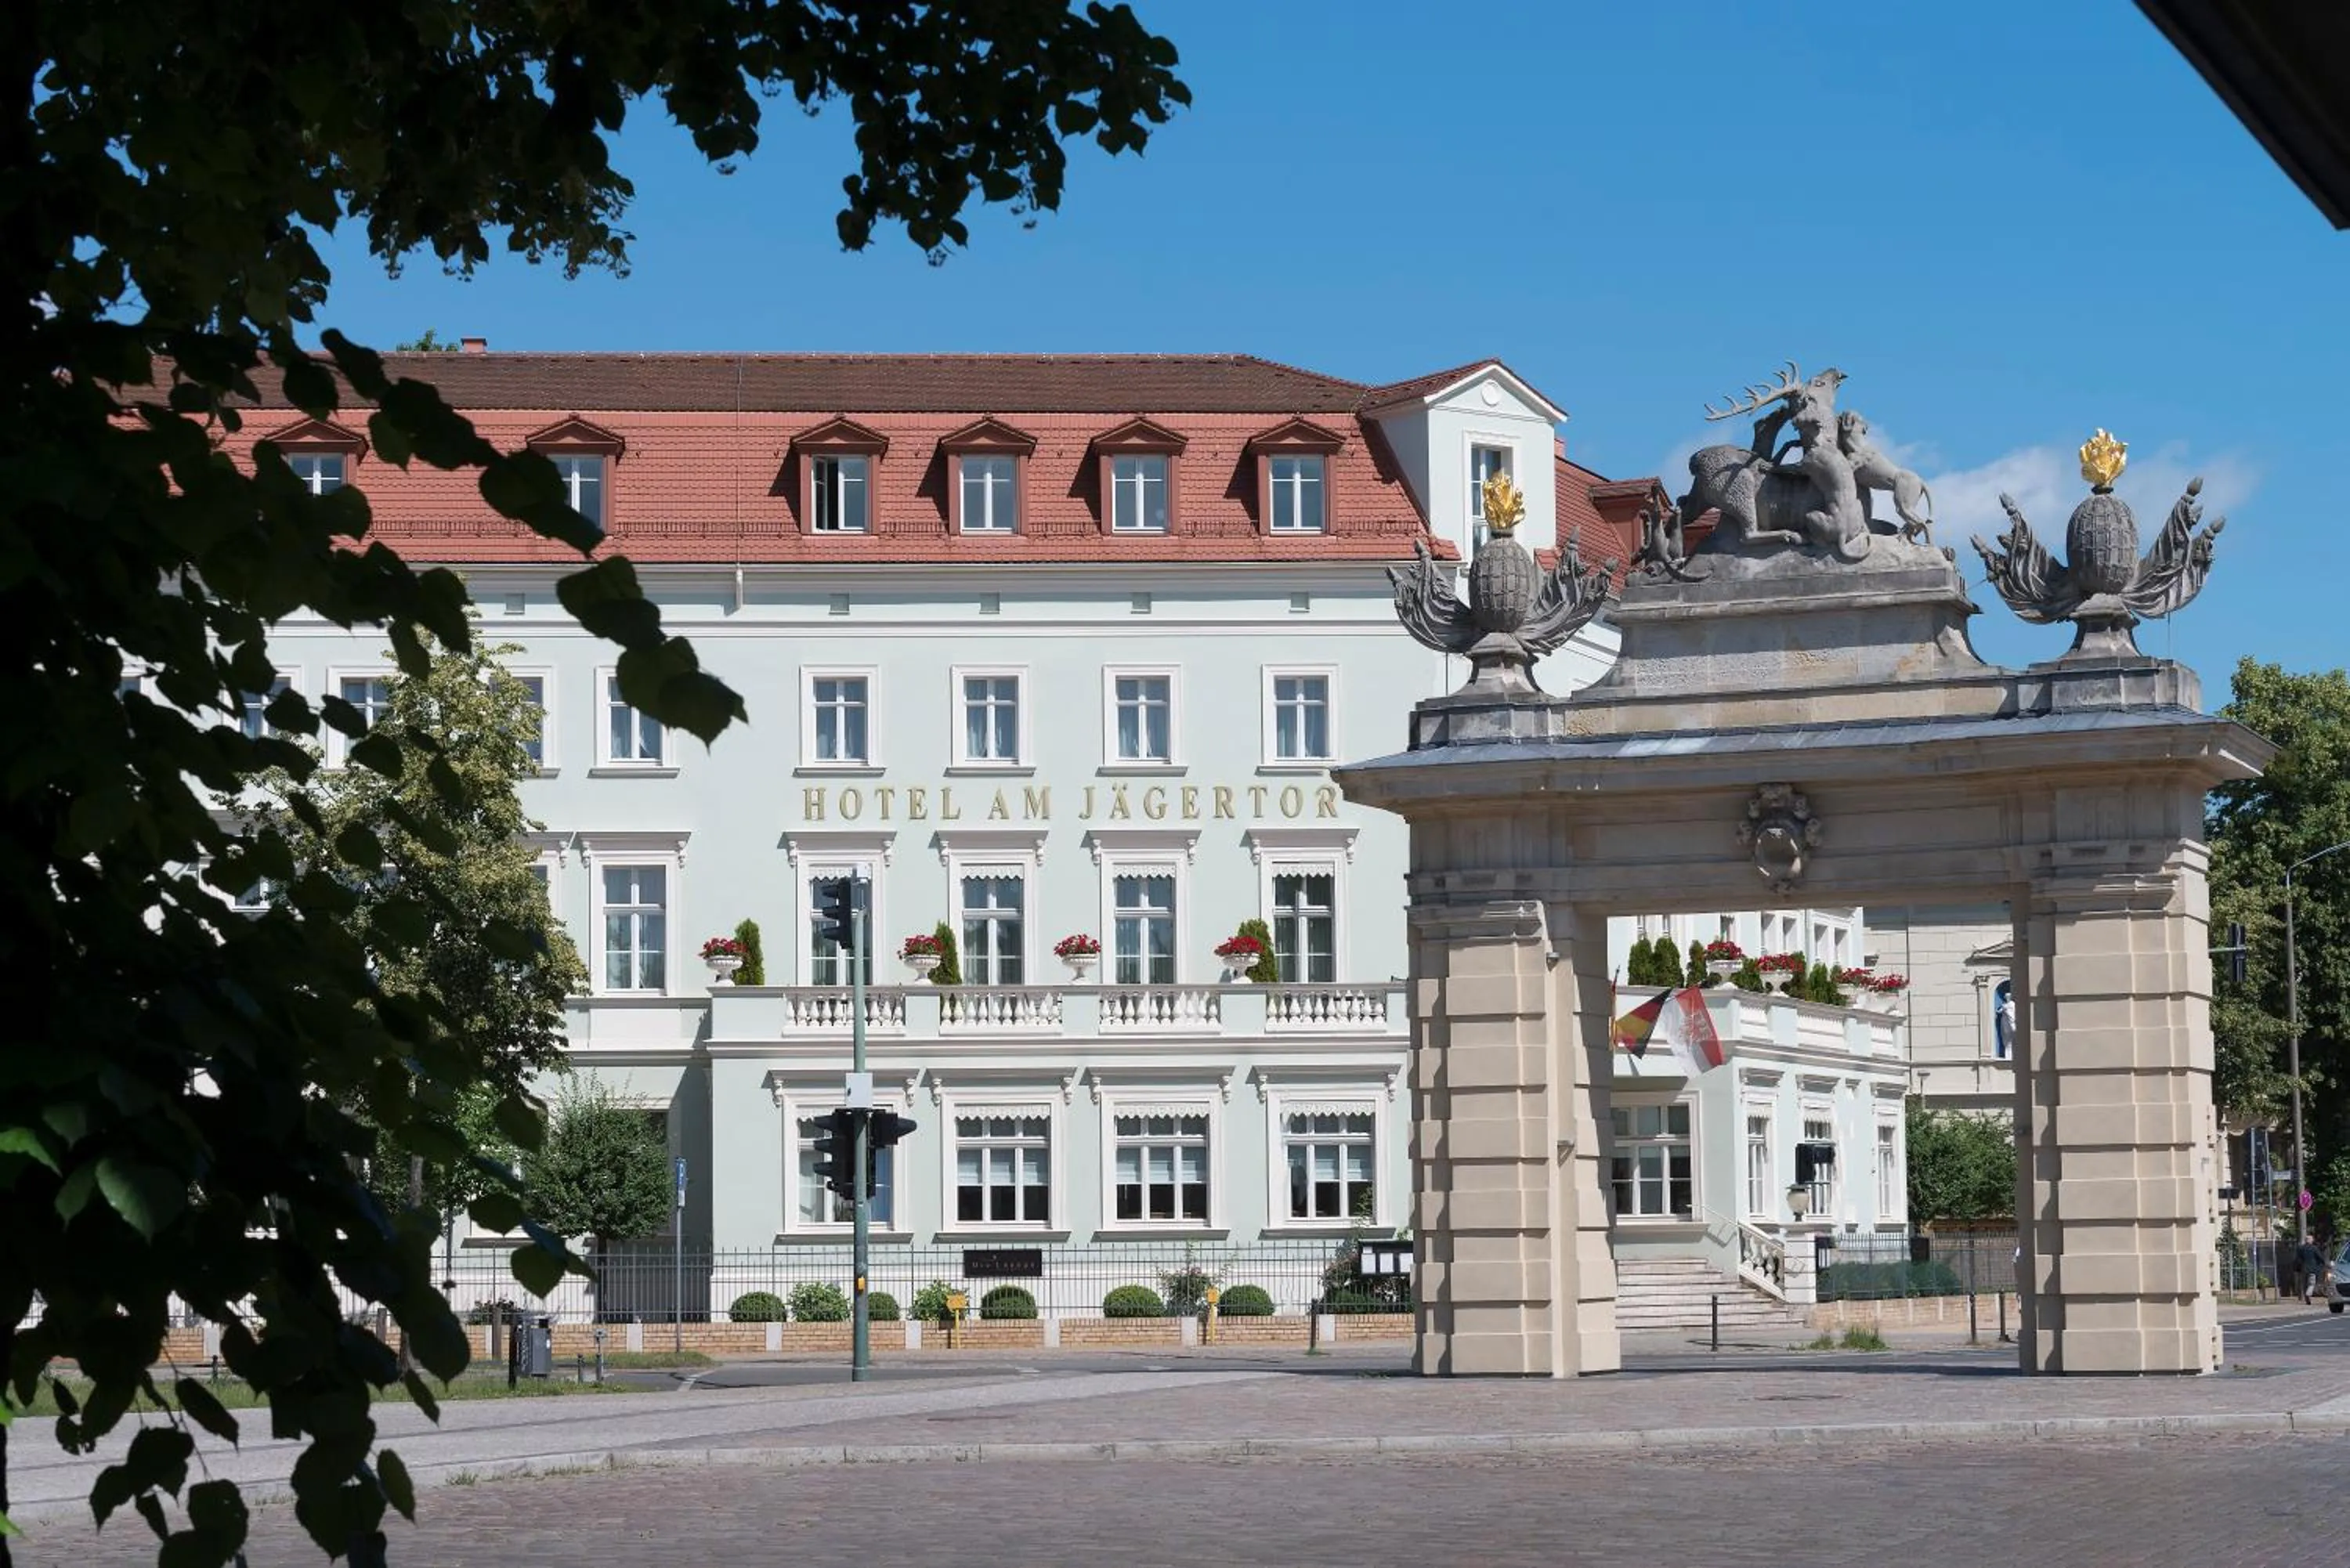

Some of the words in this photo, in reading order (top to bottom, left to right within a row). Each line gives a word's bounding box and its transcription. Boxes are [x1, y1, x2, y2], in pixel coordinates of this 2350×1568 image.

[802, 786, 962, 821] HOTEL
[987, 786, 1052, 821] AM
[1078, 782, 1339, 819] JÄGERTOR
